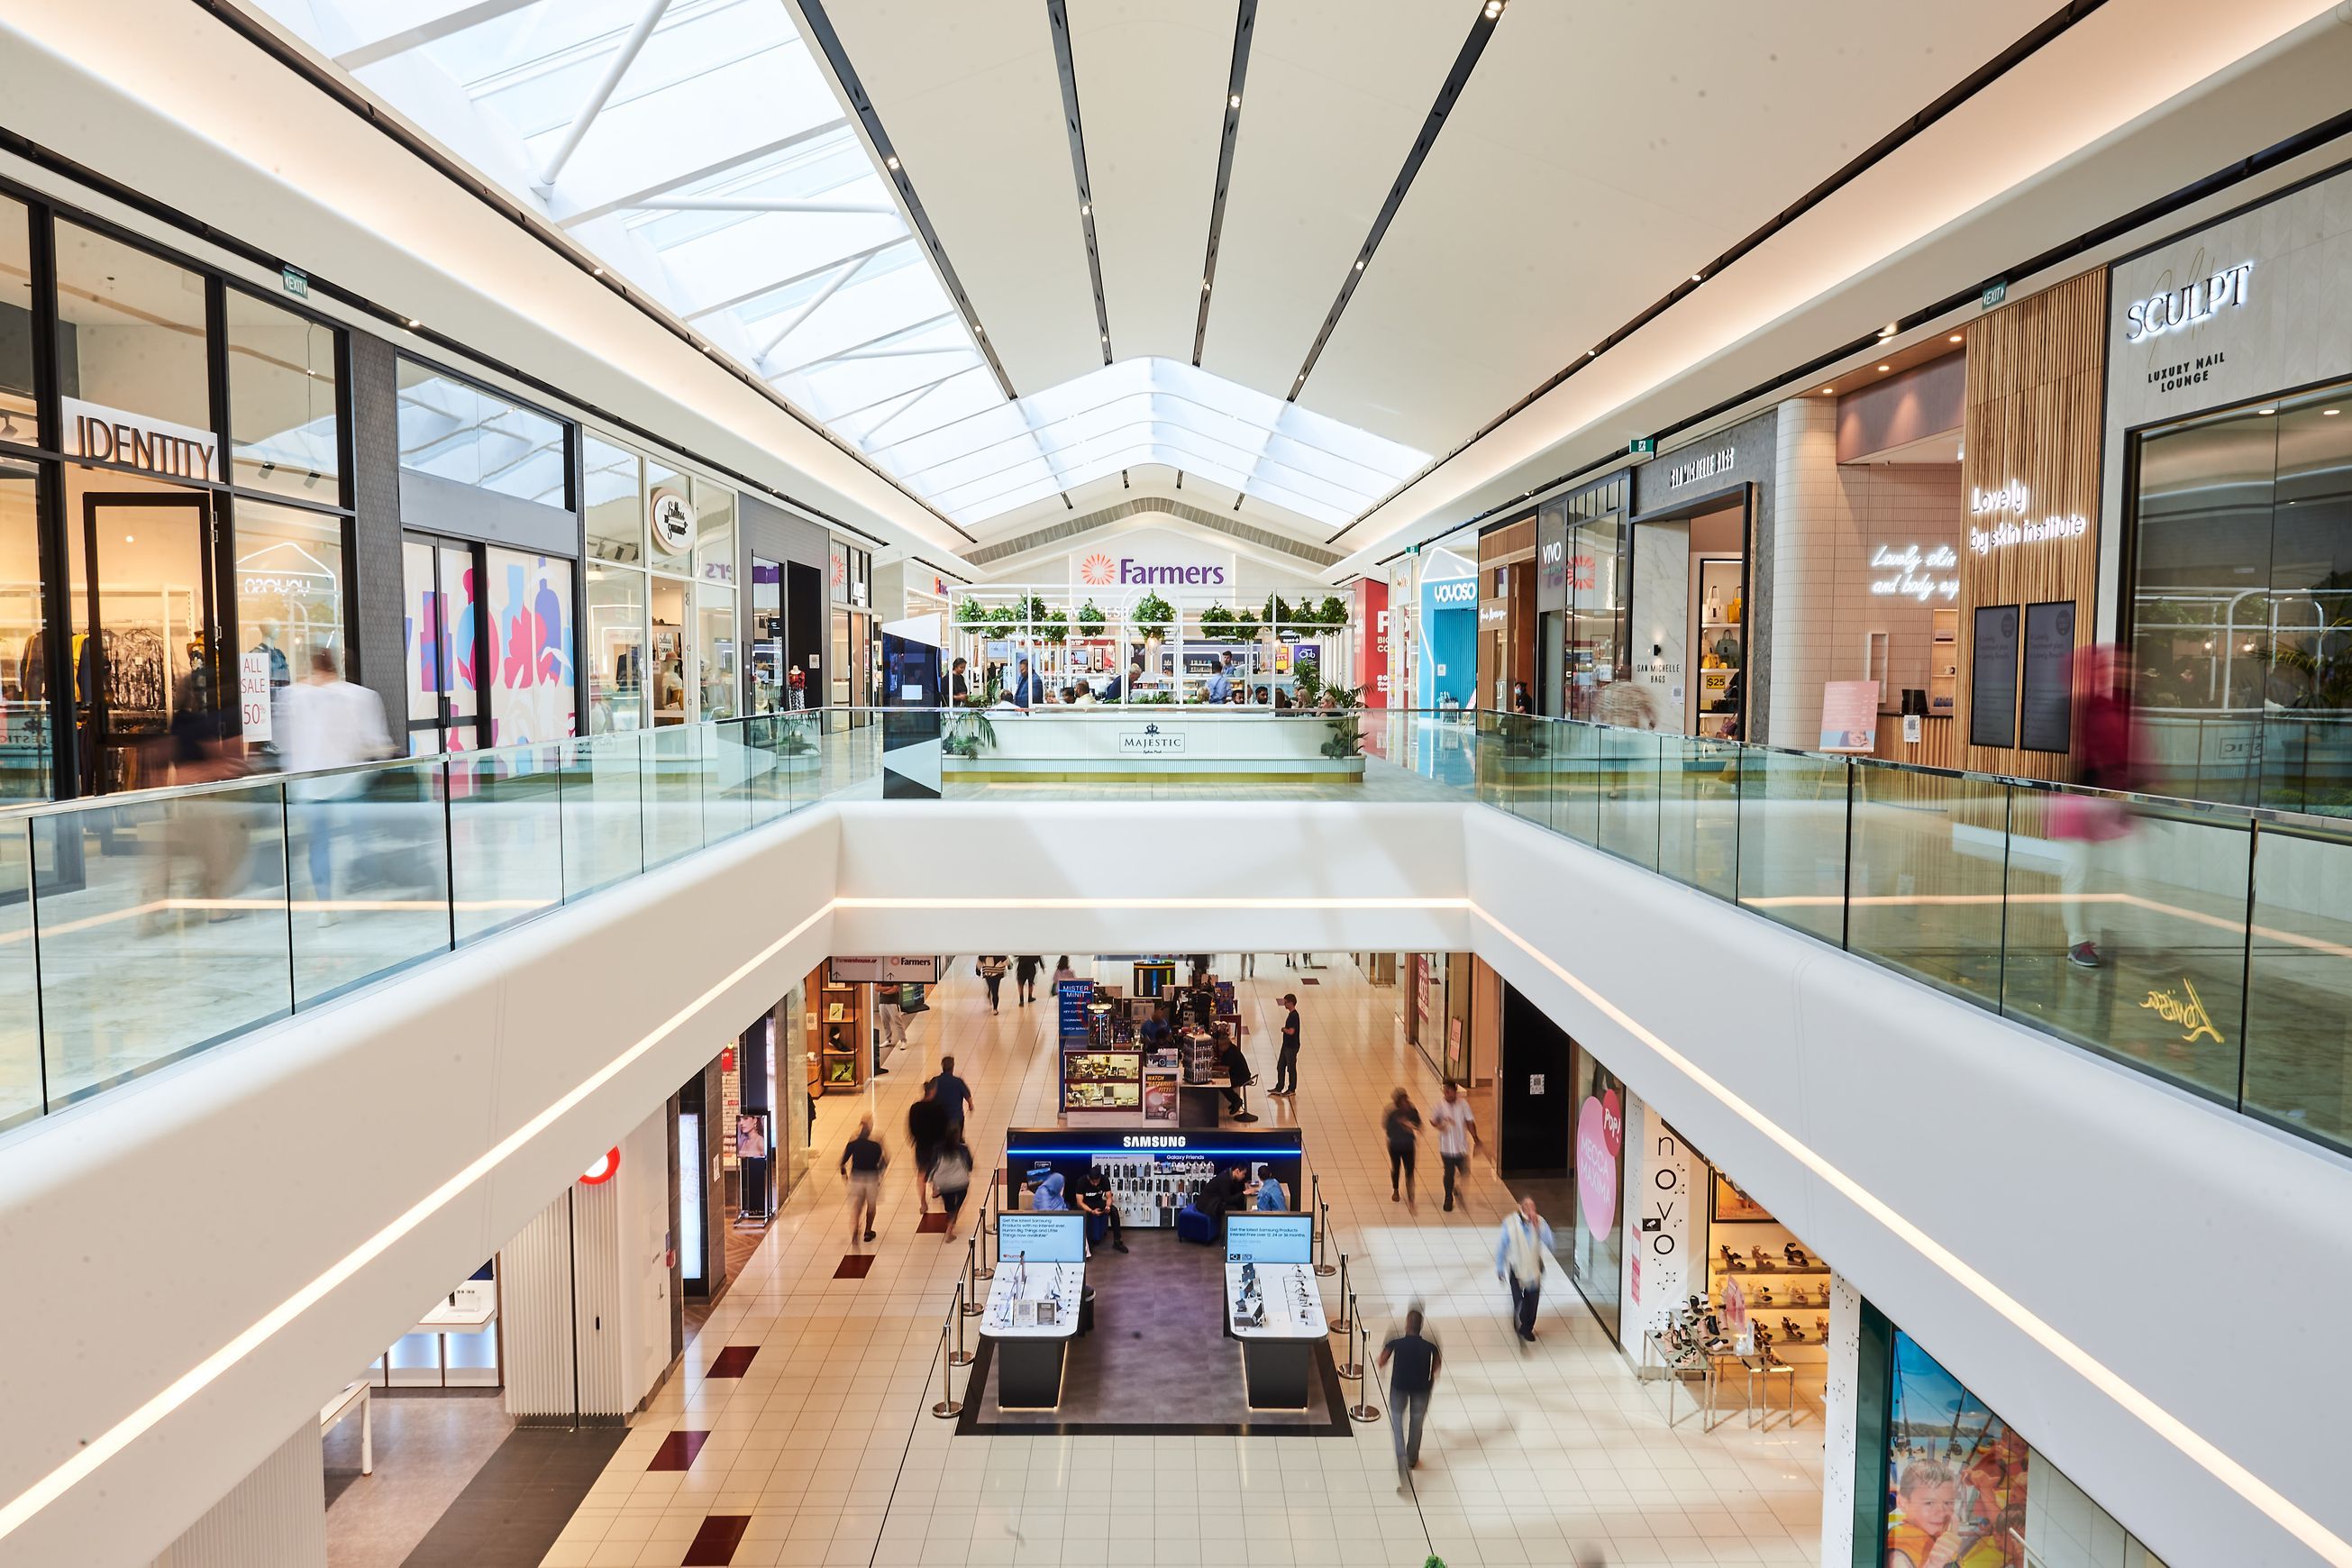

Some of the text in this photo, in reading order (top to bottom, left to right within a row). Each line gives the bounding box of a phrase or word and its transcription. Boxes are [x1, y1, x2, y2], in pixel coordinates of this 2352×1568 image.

[288, 276, 303, 294] EXIT
[1986, 287, 2001, 305] EXIT
[2126, 265, 2250, 340] SCULPT
[2147, 352, 2225, 383] LUXURY NAIL
[2161, 370, 2209, 392] LOUNGE
[77, 415, 214, 482] IDENTITY
[1972, 479, 2027, 515] Lovely
[1971, 513, 2086, 554] by skin institute
[1542, 541, 1562, 564] VIVO
[1872, 545, 1957, 573] Lovely skin
[1120, 558, 1225, 585] Farmers
[1873, 574, 1901, 593] and
[1902, 573, 1936, 601] body
[243, 658, 262, 673] ALL
[1636, 664, 1680, 672] SAN MICHELLE
[241, 679, 266, 694] SALE
[1650, 675, 1665, 684] BAGS
[1708, 678, 1725, 688] $25
[1124, 737, 1181, 748] MAJESTIC
[900, 956, 932, 966] Farmers
[1123, 1135, 1186, 1148] SAMSUNG
[1581, 1132, 1609, 1178] MECCA
[1580, 1155, 1611, 1206] MAXIMA
[1655, 1136, 1677, 1255] novo
